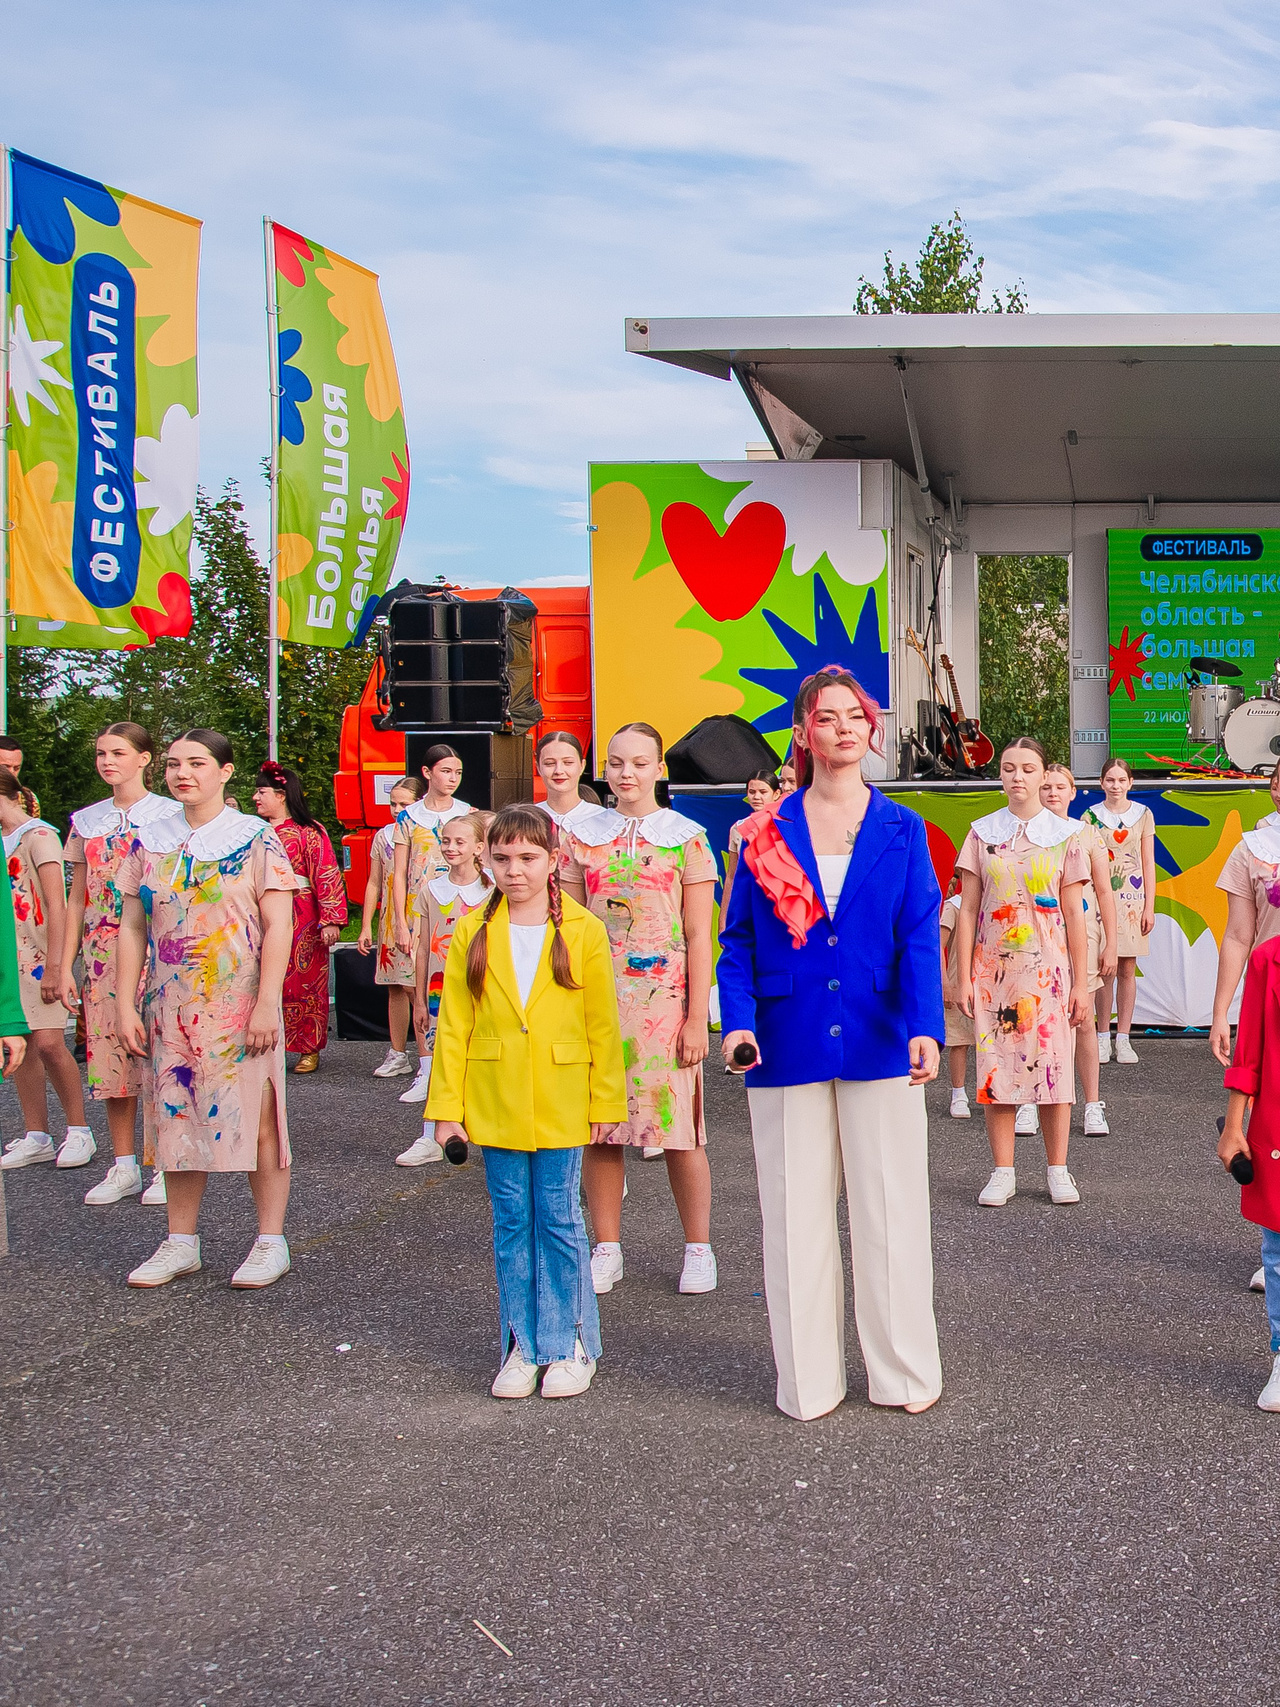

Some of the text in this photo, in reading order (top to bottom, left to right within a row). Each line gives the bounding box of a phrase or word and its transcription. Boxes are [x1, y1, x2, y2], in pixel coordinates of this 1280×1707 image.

[87, 280, 126, 583] ФЕСТИВАЛЬ
[306, 383, 349, 629] Большая
[1152, 539, 1251, 556] ФЕСТИВАЛЬ
[1140, 601, 1245, 626] область
[1141, 633, 1255, 658] большая
[1143, 710, 1191, 723] 22 ИЮЛ
